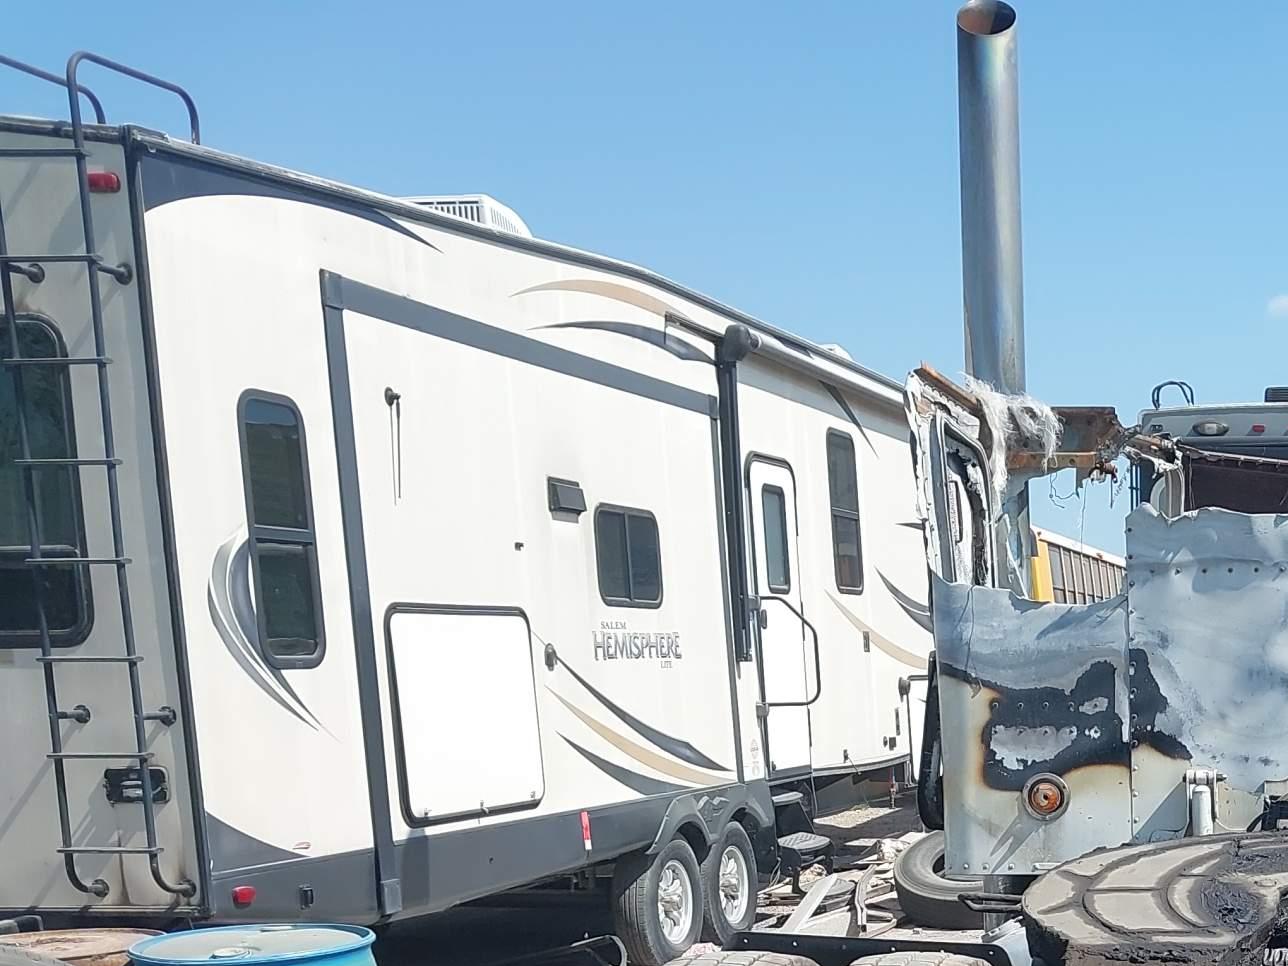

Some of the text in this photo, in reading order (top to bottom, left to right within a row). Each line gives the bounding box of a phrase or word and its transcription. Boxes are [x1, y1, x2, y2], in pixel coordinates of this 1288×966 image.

[600, 620, 627, 630] SALEM
[592, 630, 683, 661] HEMISPHERE
[660, 660, 673, 669] LITE
